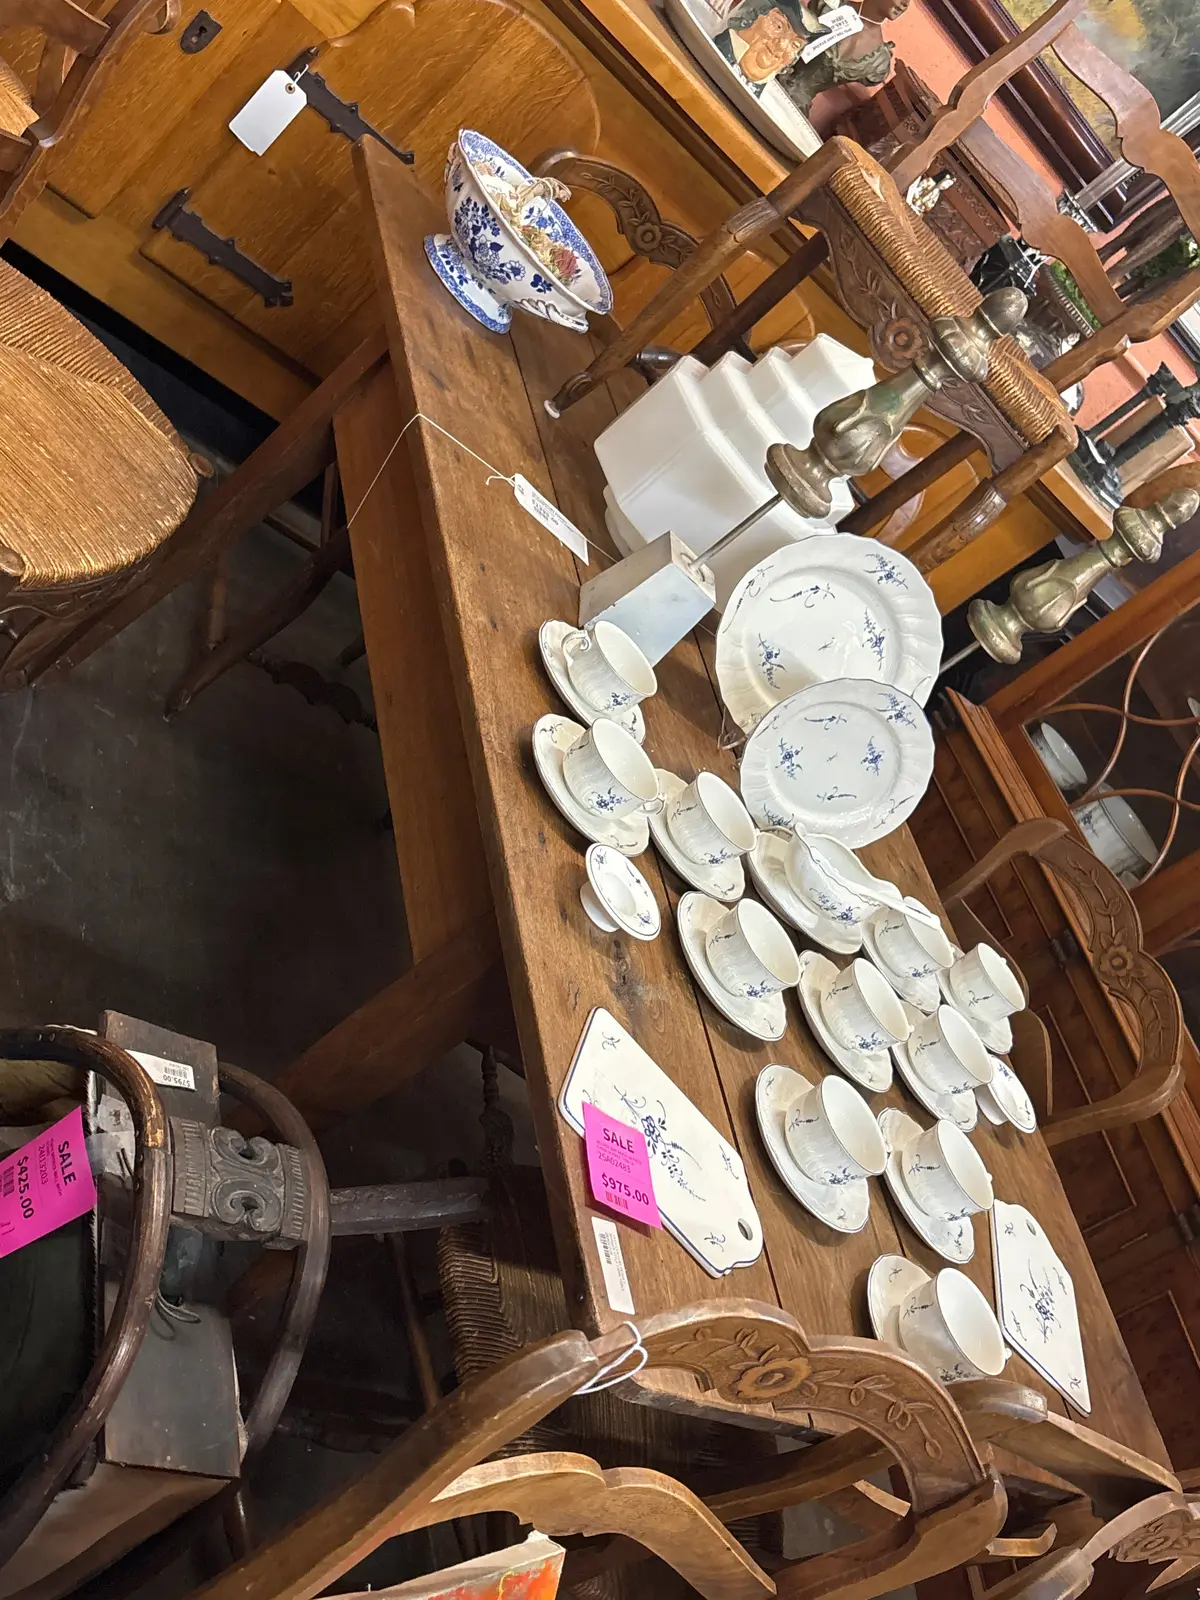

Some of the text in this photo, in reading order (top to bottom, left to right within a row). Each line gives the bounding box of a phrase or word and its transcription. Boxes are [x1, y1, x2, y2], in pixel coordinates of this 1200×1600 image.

[163, 1074, 191, 1087] $795.00
[603, 1128, 634, 1154] SALE
[58, 1140, 76, 1186] SALE
[17, 1156, 34, 1219] $425.00
[602, 1172, 649, 1206] $975.00
